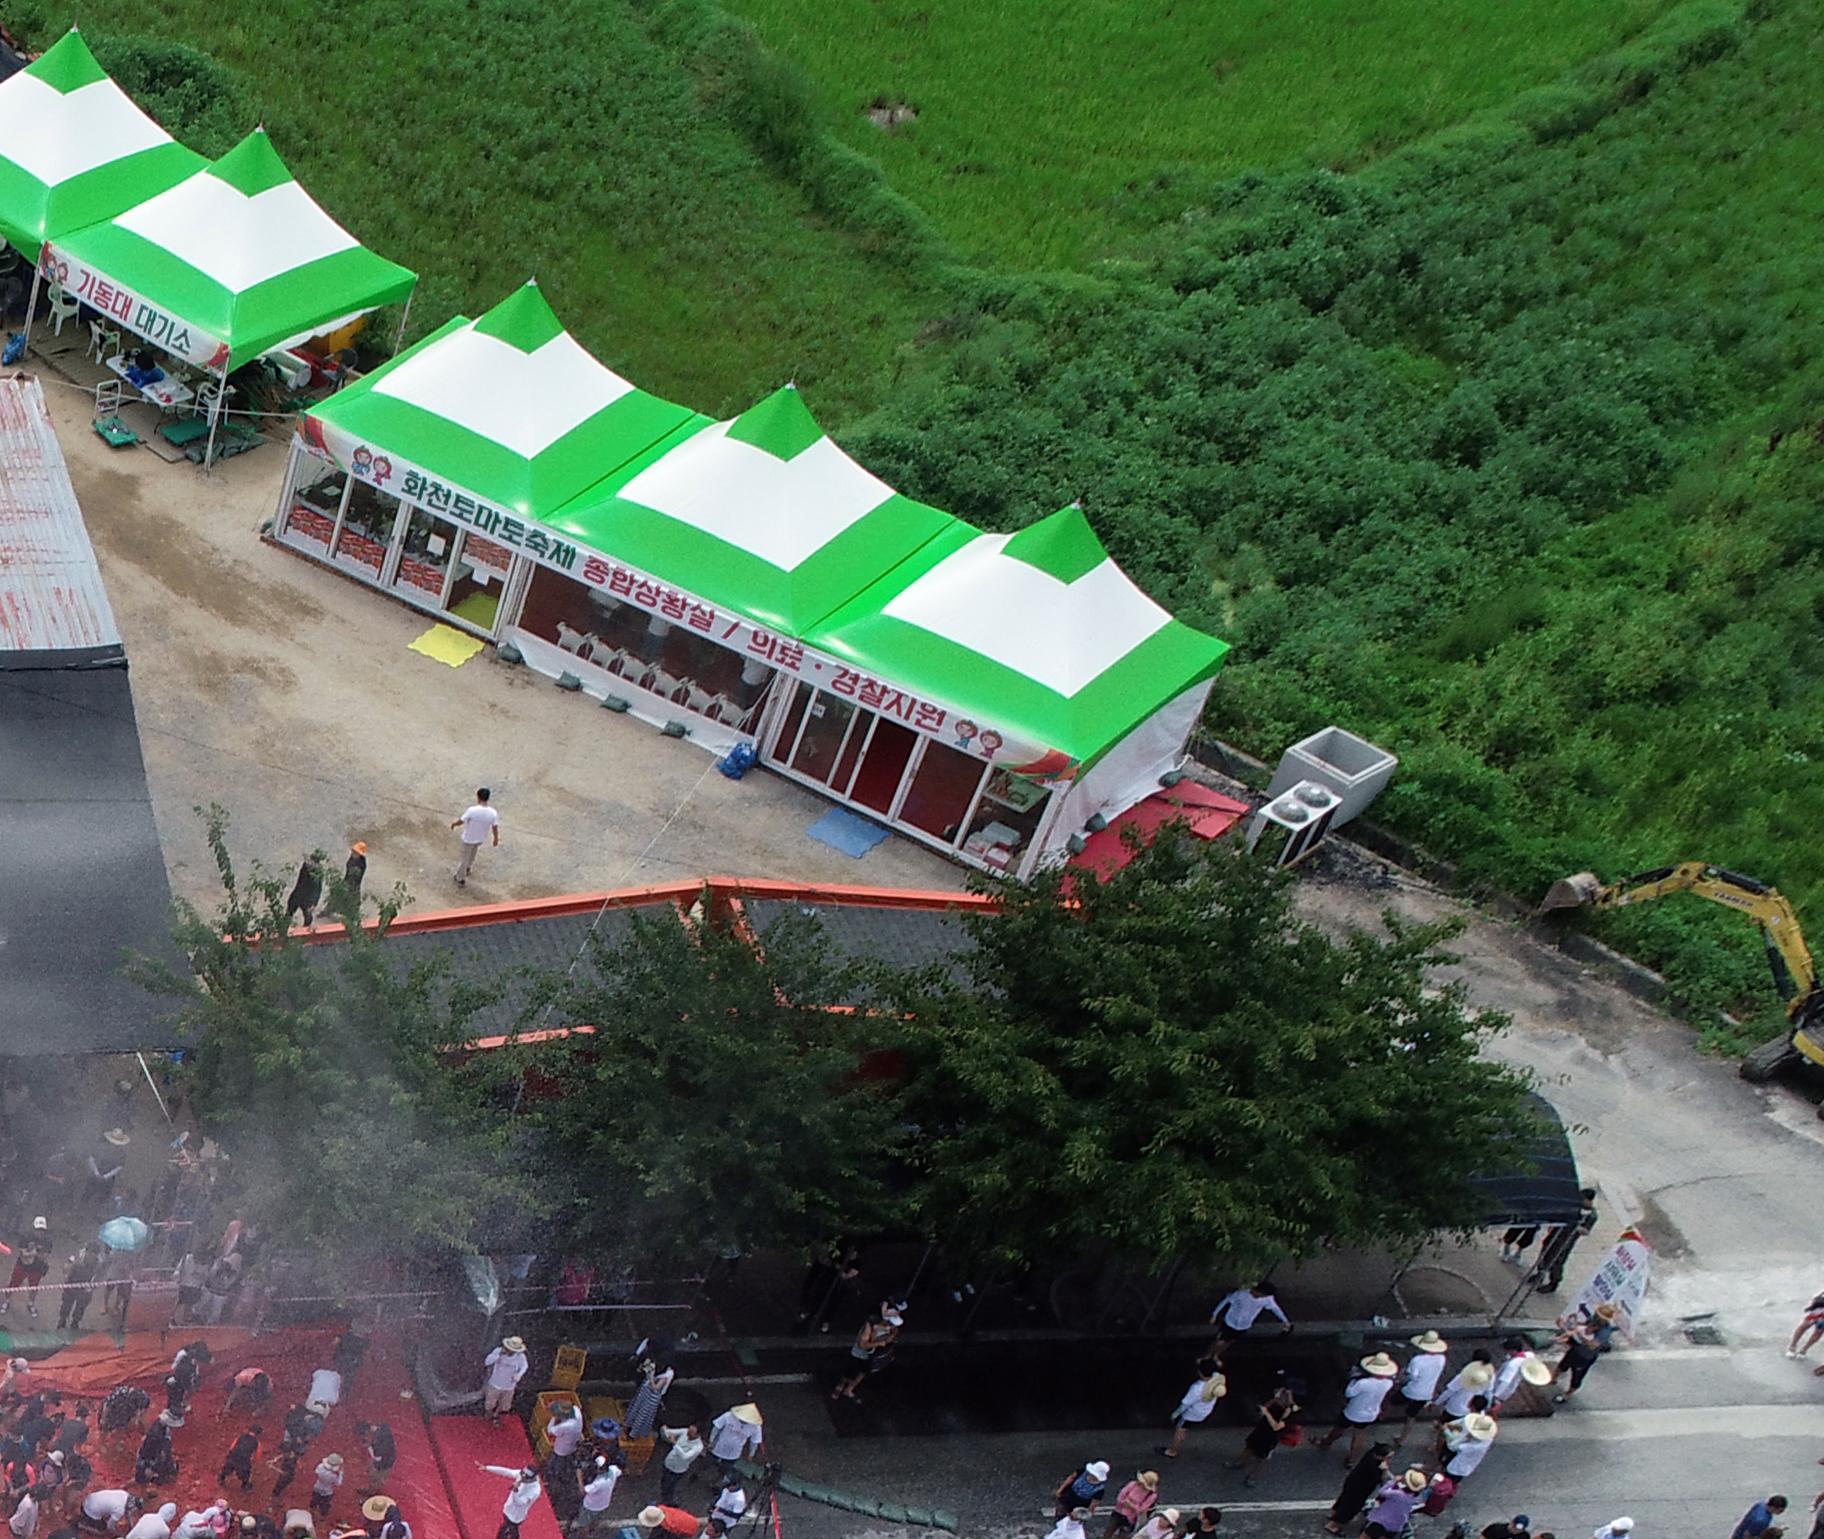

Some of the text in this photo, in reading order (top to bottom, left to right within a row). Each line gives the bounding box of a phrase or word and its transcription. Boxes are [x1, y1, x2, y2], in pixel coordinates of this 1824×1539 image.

[77, 268, 191, 356] 기동대 대기소
[401, 468, 577, 571] 화천토마토축제
[582, 553, 716, 633] 종합상황실
[747, 629, 805, 672] 의료
[830, 663, 948, 733] 경찰지원
